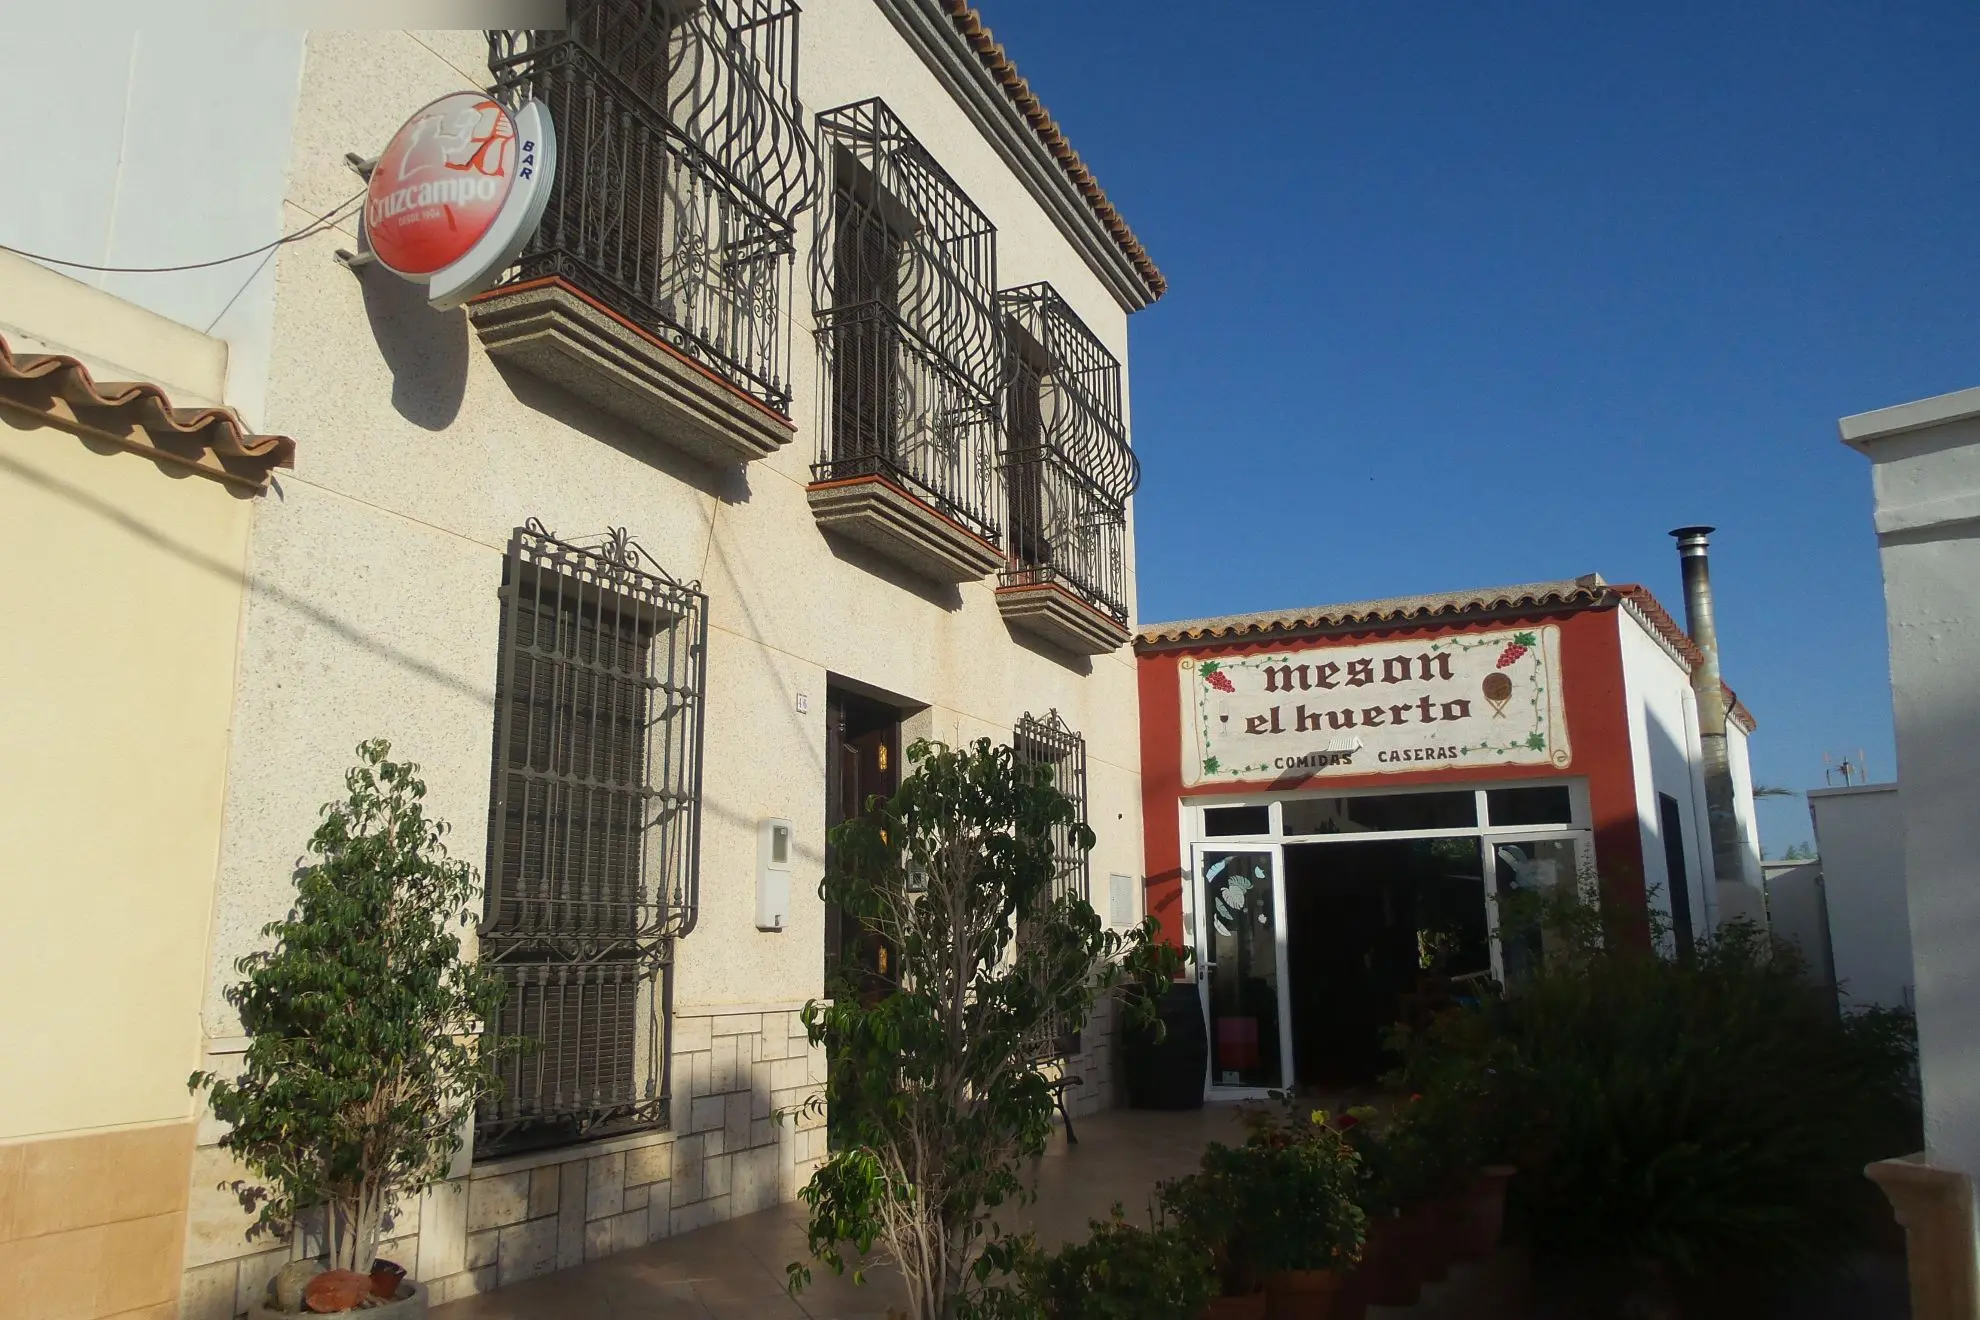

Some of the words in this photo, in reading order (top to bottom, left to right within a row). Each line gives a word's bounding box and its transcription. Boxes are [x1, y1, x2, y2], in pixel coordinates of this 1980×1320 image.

[519, 140, 535, 180] BAR
[370, 177, 496, 228] Cruzcampo
[1263, 651, 1455, 693] meson
[1244, 705, 1286, 735] el
[1294, 694, 1472, 733] huerto
[1274, 753, 1353, 770] COMIDAS
[1378, 746, 1457, 763] CASERAS
